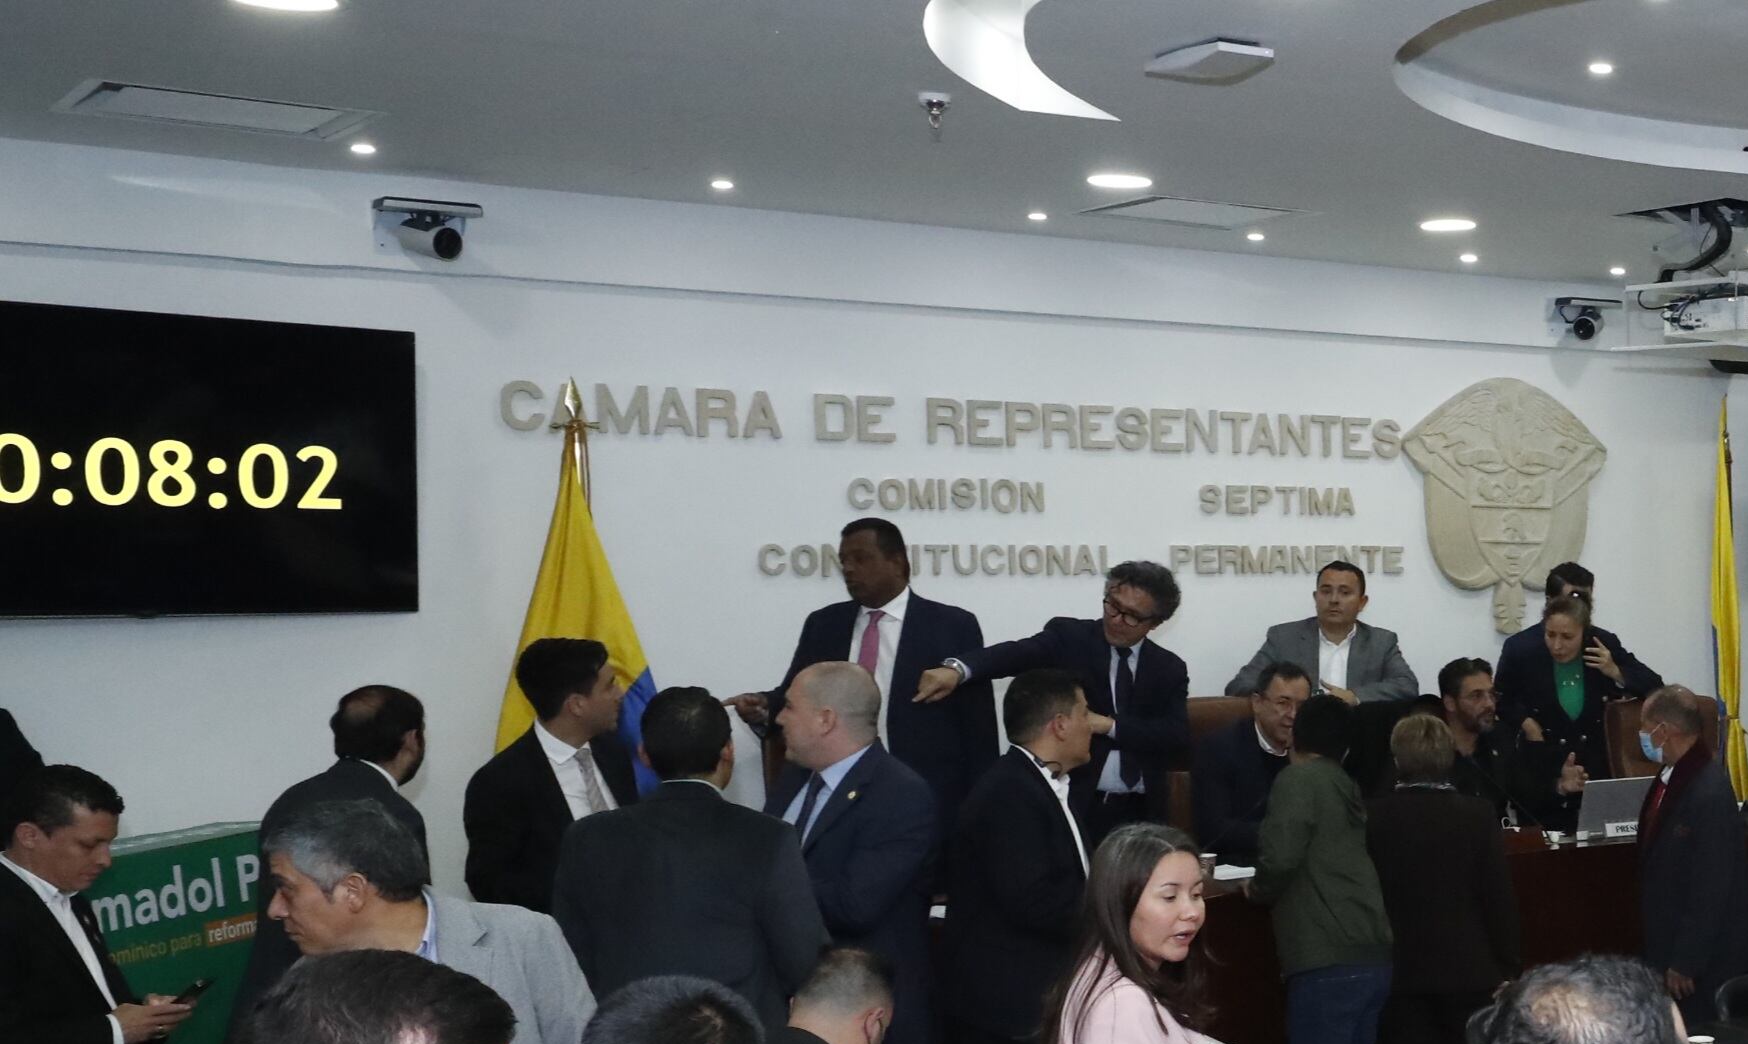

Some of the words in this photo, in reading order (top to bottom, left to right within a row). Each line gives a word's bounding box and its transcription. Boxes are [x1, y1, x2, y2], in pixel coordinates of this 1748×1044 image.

[814, 393, 897, 444] DE
[926, 397, 1401, 460] REPRESENTANTES
[848, 477, 1046, 514] COMISION
[1199, 484, 1356, 516] SEPTIMA
[758, 543, 1110, 578] CONITUCIONAL
[92, 857, 226, 934] madol
